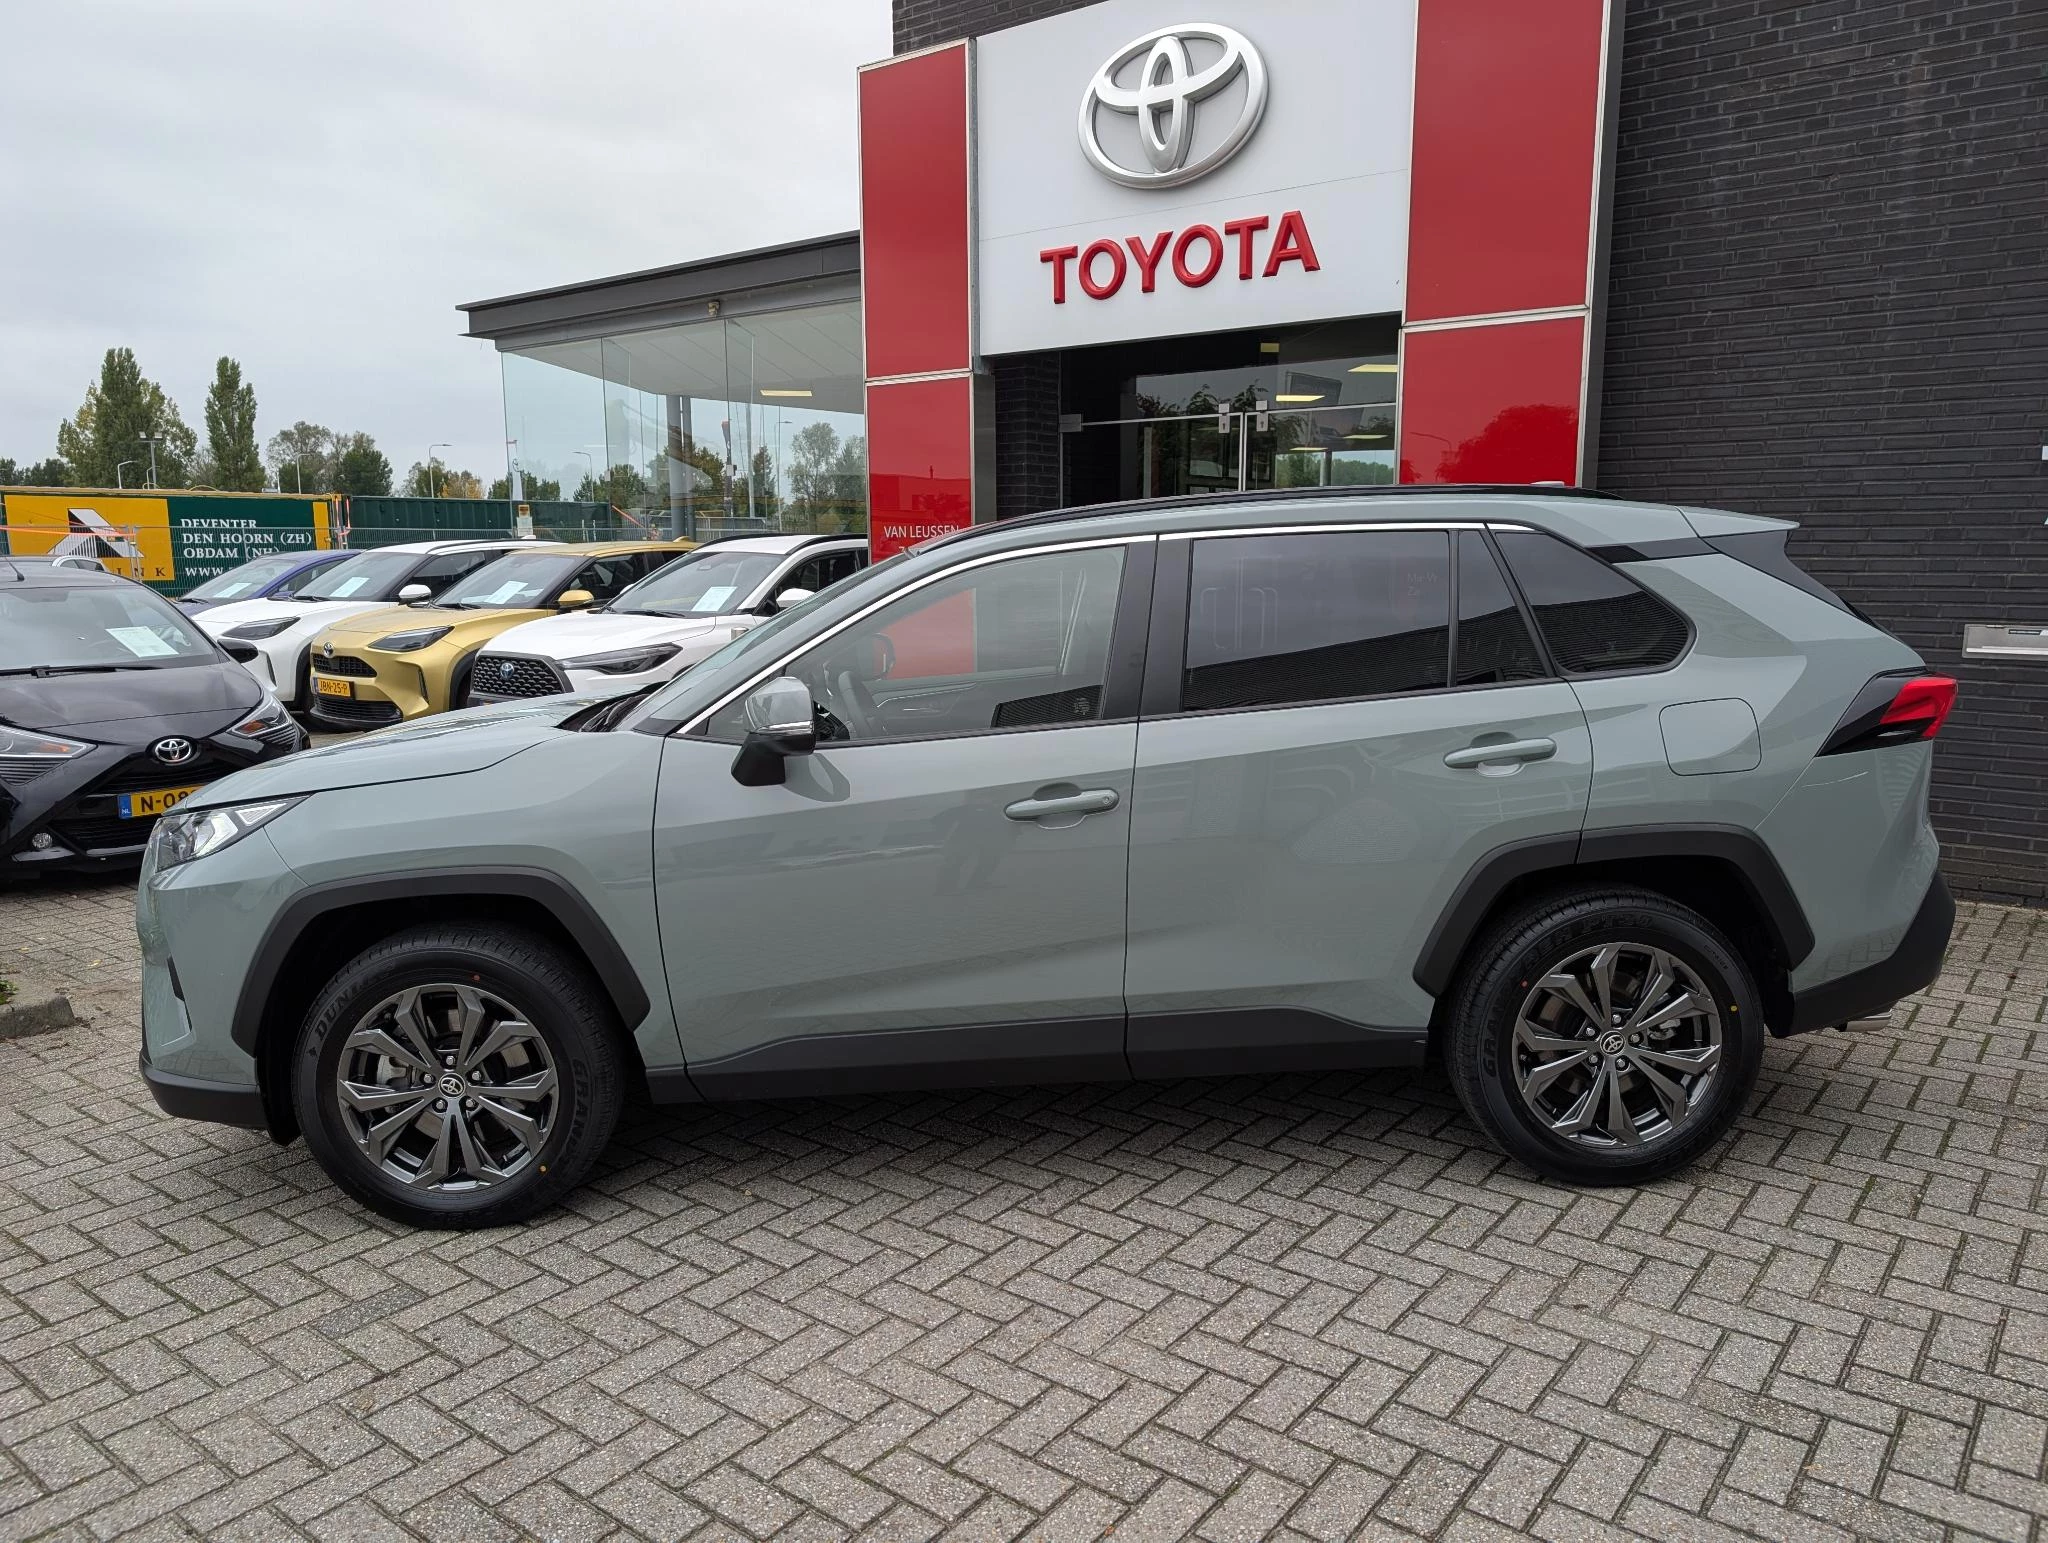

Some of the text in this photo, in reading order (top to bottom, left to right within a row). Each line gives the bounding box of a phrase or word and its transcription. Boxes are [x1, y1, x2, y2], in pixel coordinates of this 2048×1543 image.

[1040, 210, 1321, 304] TOYOTA
[181, 519, 257, 528] DEVENTER
[884, 525, 959, 538] VAN LEUSSEN
[182, 532, 313, 545] DEN HOORN (ZH)
[183, 548, 238, 558] OBDAM
[185, 567, 224, 577] WWW
